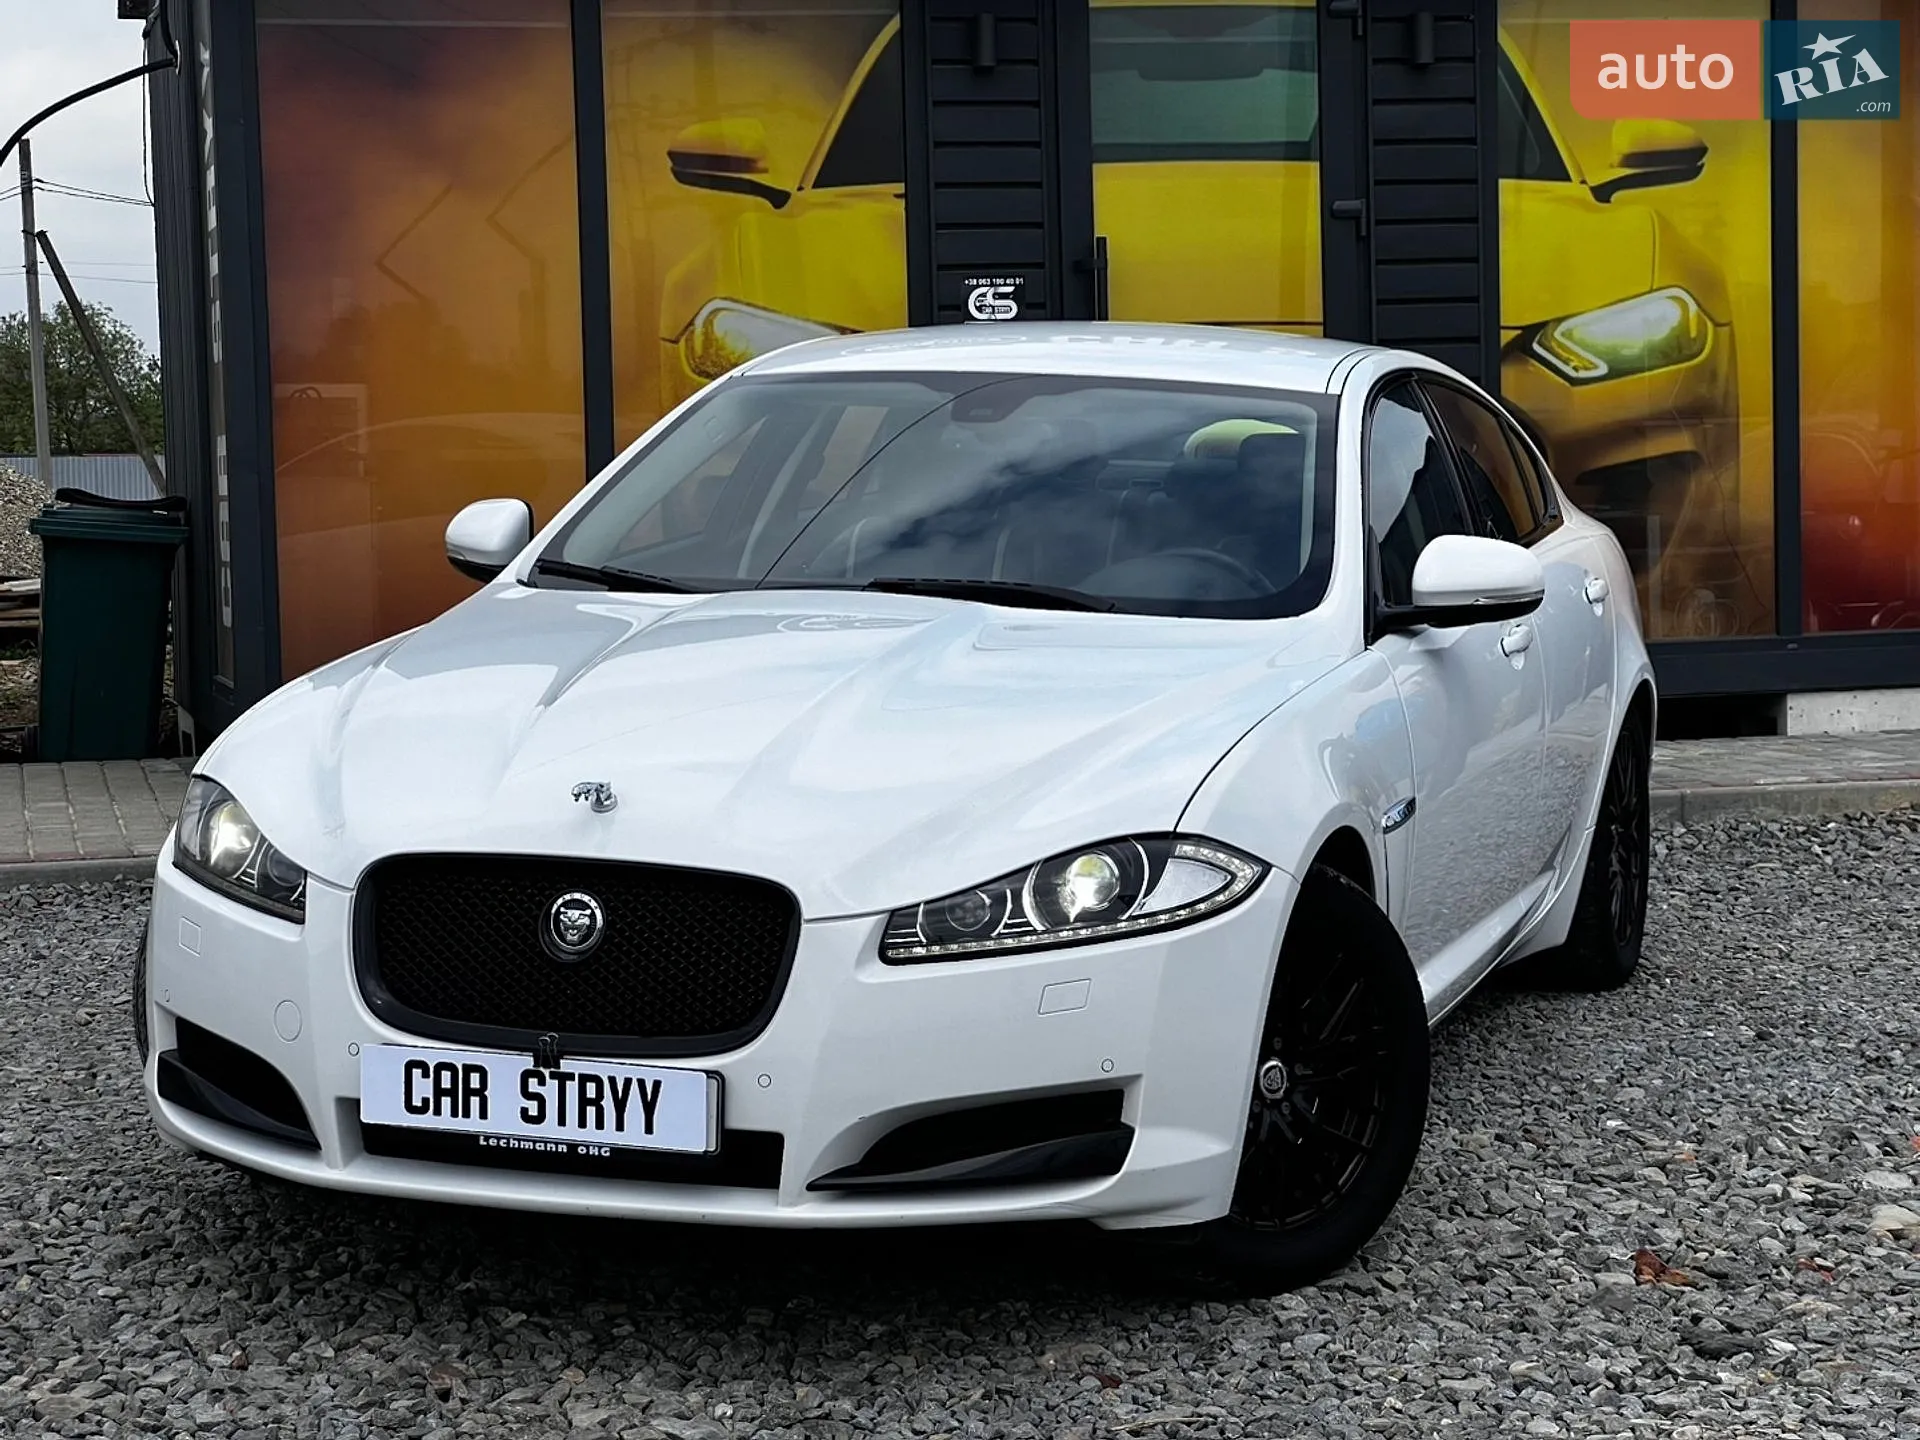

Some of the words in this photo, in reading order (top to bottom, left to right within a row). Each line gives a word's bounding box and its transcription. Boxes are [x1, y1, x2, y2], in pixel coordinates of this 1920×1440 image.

[216, 434, 233, 629] CAR
[403, 1058, 489, 1121] CAR
[519, 1068, 662, 1136] STRYY
[478, 1135, 568, 1153] Lechmann
